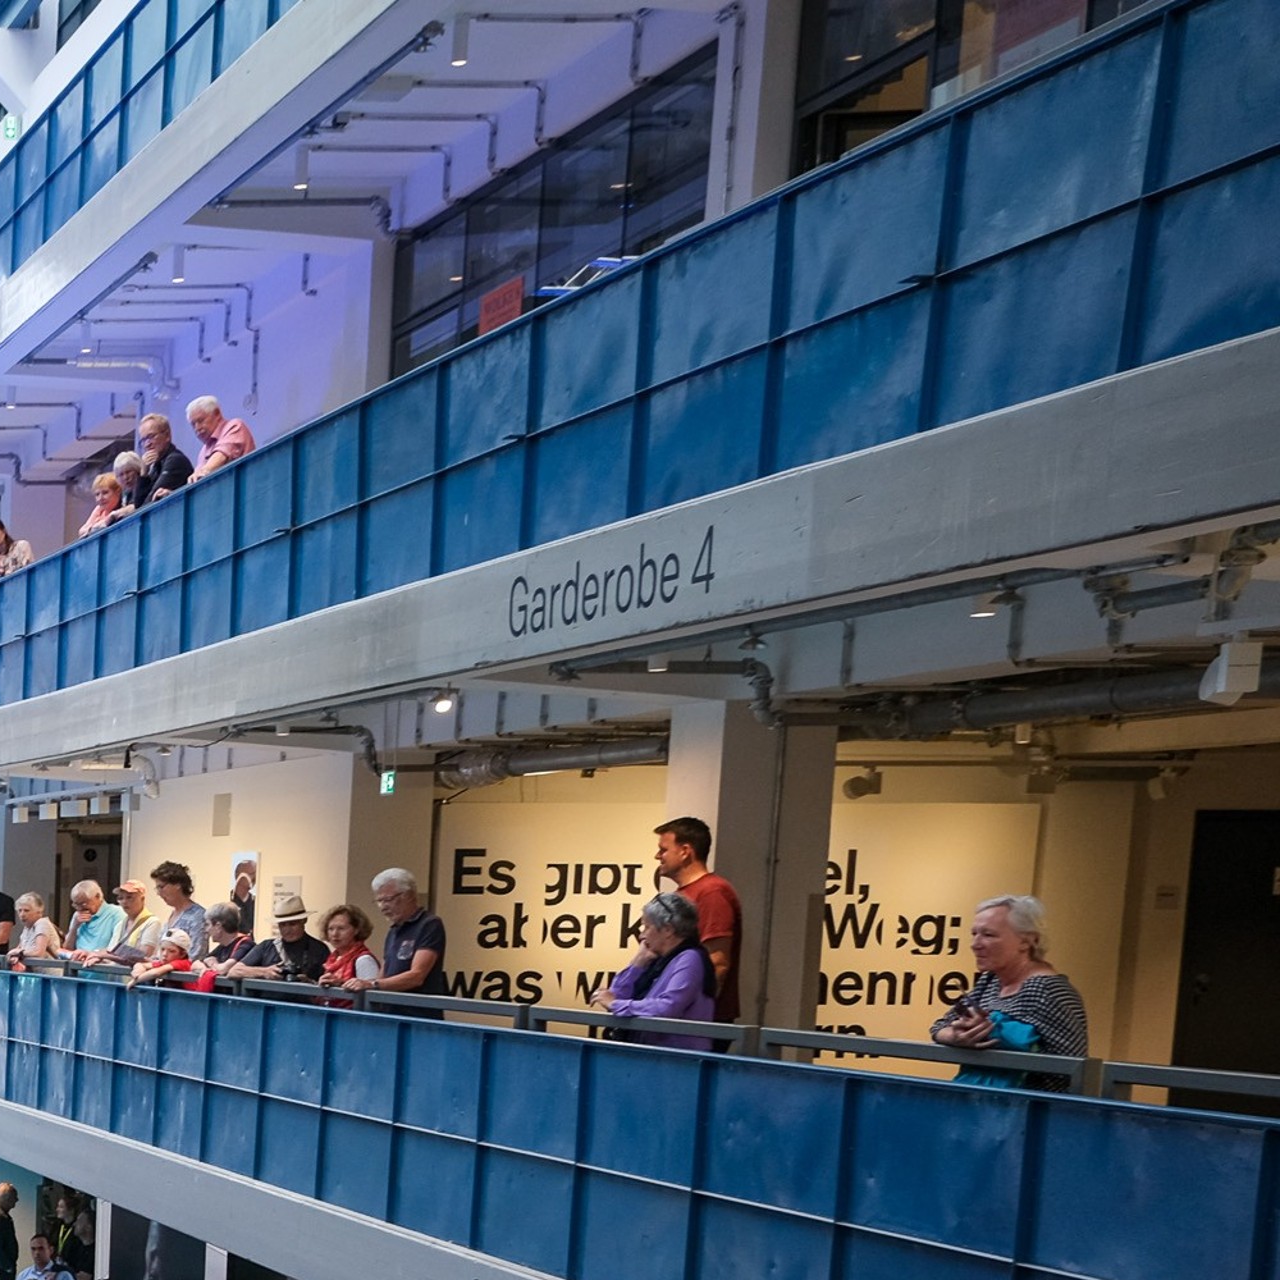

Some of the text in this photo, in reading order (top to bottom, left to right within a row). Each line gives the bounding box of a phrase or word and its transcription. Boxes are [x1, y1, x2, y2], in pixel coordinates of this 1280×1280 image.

[509, 525, 716, 637] Garderobe 4
[452, 848, 517, 895] Es
[442, 970, 543, 1005] was
